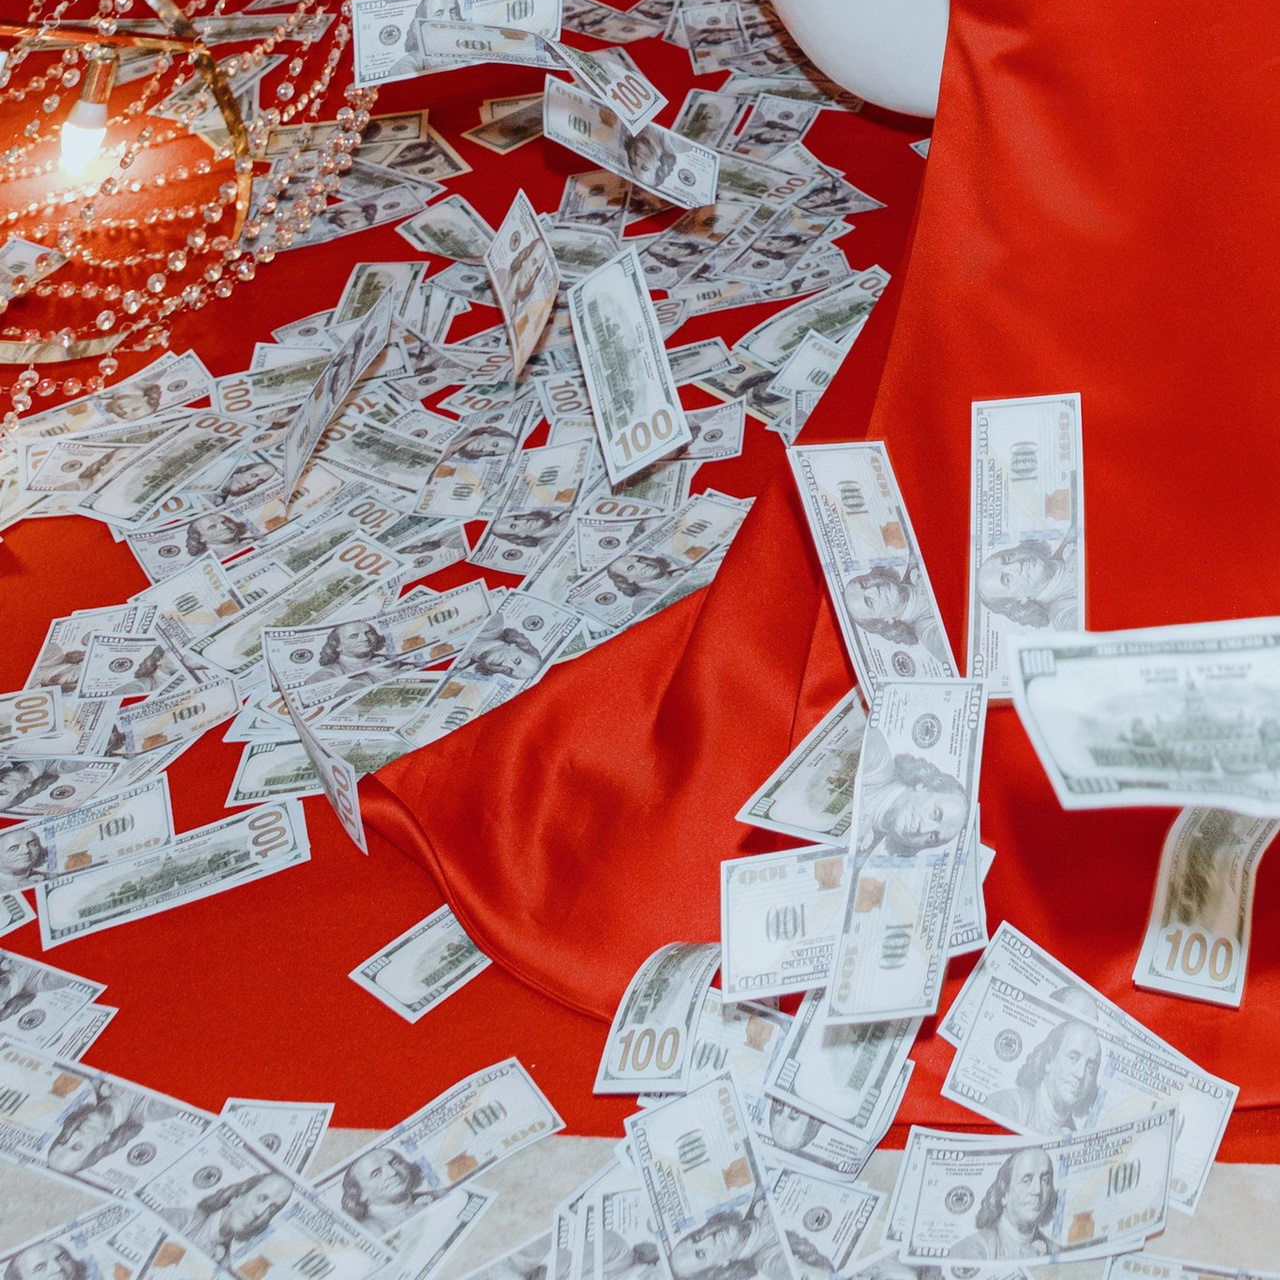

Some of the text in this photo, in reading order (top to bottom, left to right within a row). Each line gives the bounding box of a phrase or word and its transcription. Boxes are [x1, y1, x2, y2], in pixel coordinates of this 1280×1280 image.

[359, 0, 388, 9] 100
[362, 70, 390, 82] 100
[609, 74, 653, 116] 100
[769, 176, 807, 202] 100
[472, 353, 512, 382] 100
[220, 378, 253, 413] 100
[459, 395, 512, 414] 100
[552, 379, 585, 414] 100
[197, 415, 247, 438] 100
[613, 408, 673, 464] 100
[979, 418, 988, 454] 100
[802, 459, 818, 491] 100
[1010, 442, 1038, 482] 100
[837, 481, 869, 515] 100
[347, 501, 394, 528] 100
[339, 545, 393, 578] 100
[14, 697, 50, 734] 100
[870, 689, 885, 728] 100
[967, 688, 982, 729] 100
[248, 810, 290, 859] 100
[1001, 933, 1032, 959] 100
[1165, 930, 1234, 981] 100
[362, 955, 391, 978] 100
[739, 972, 778, 987] 100
[924, 954, 938, 996] 100
[990, 979, 1024, 1002] 100
[618, 1027, 680, 1071] 100
[954, 1082, 988, 1105] 100
[1190, 1076, 1224, 1099] 100
[1136, 1114, 1167, 1133] 100
[928, 1149, 965, 1161] 100
[1106, 1159, 1141, 1197] 100
[1118, 1208, 1156, 1231] 100
[915, 1246, 950, 1258] 100
